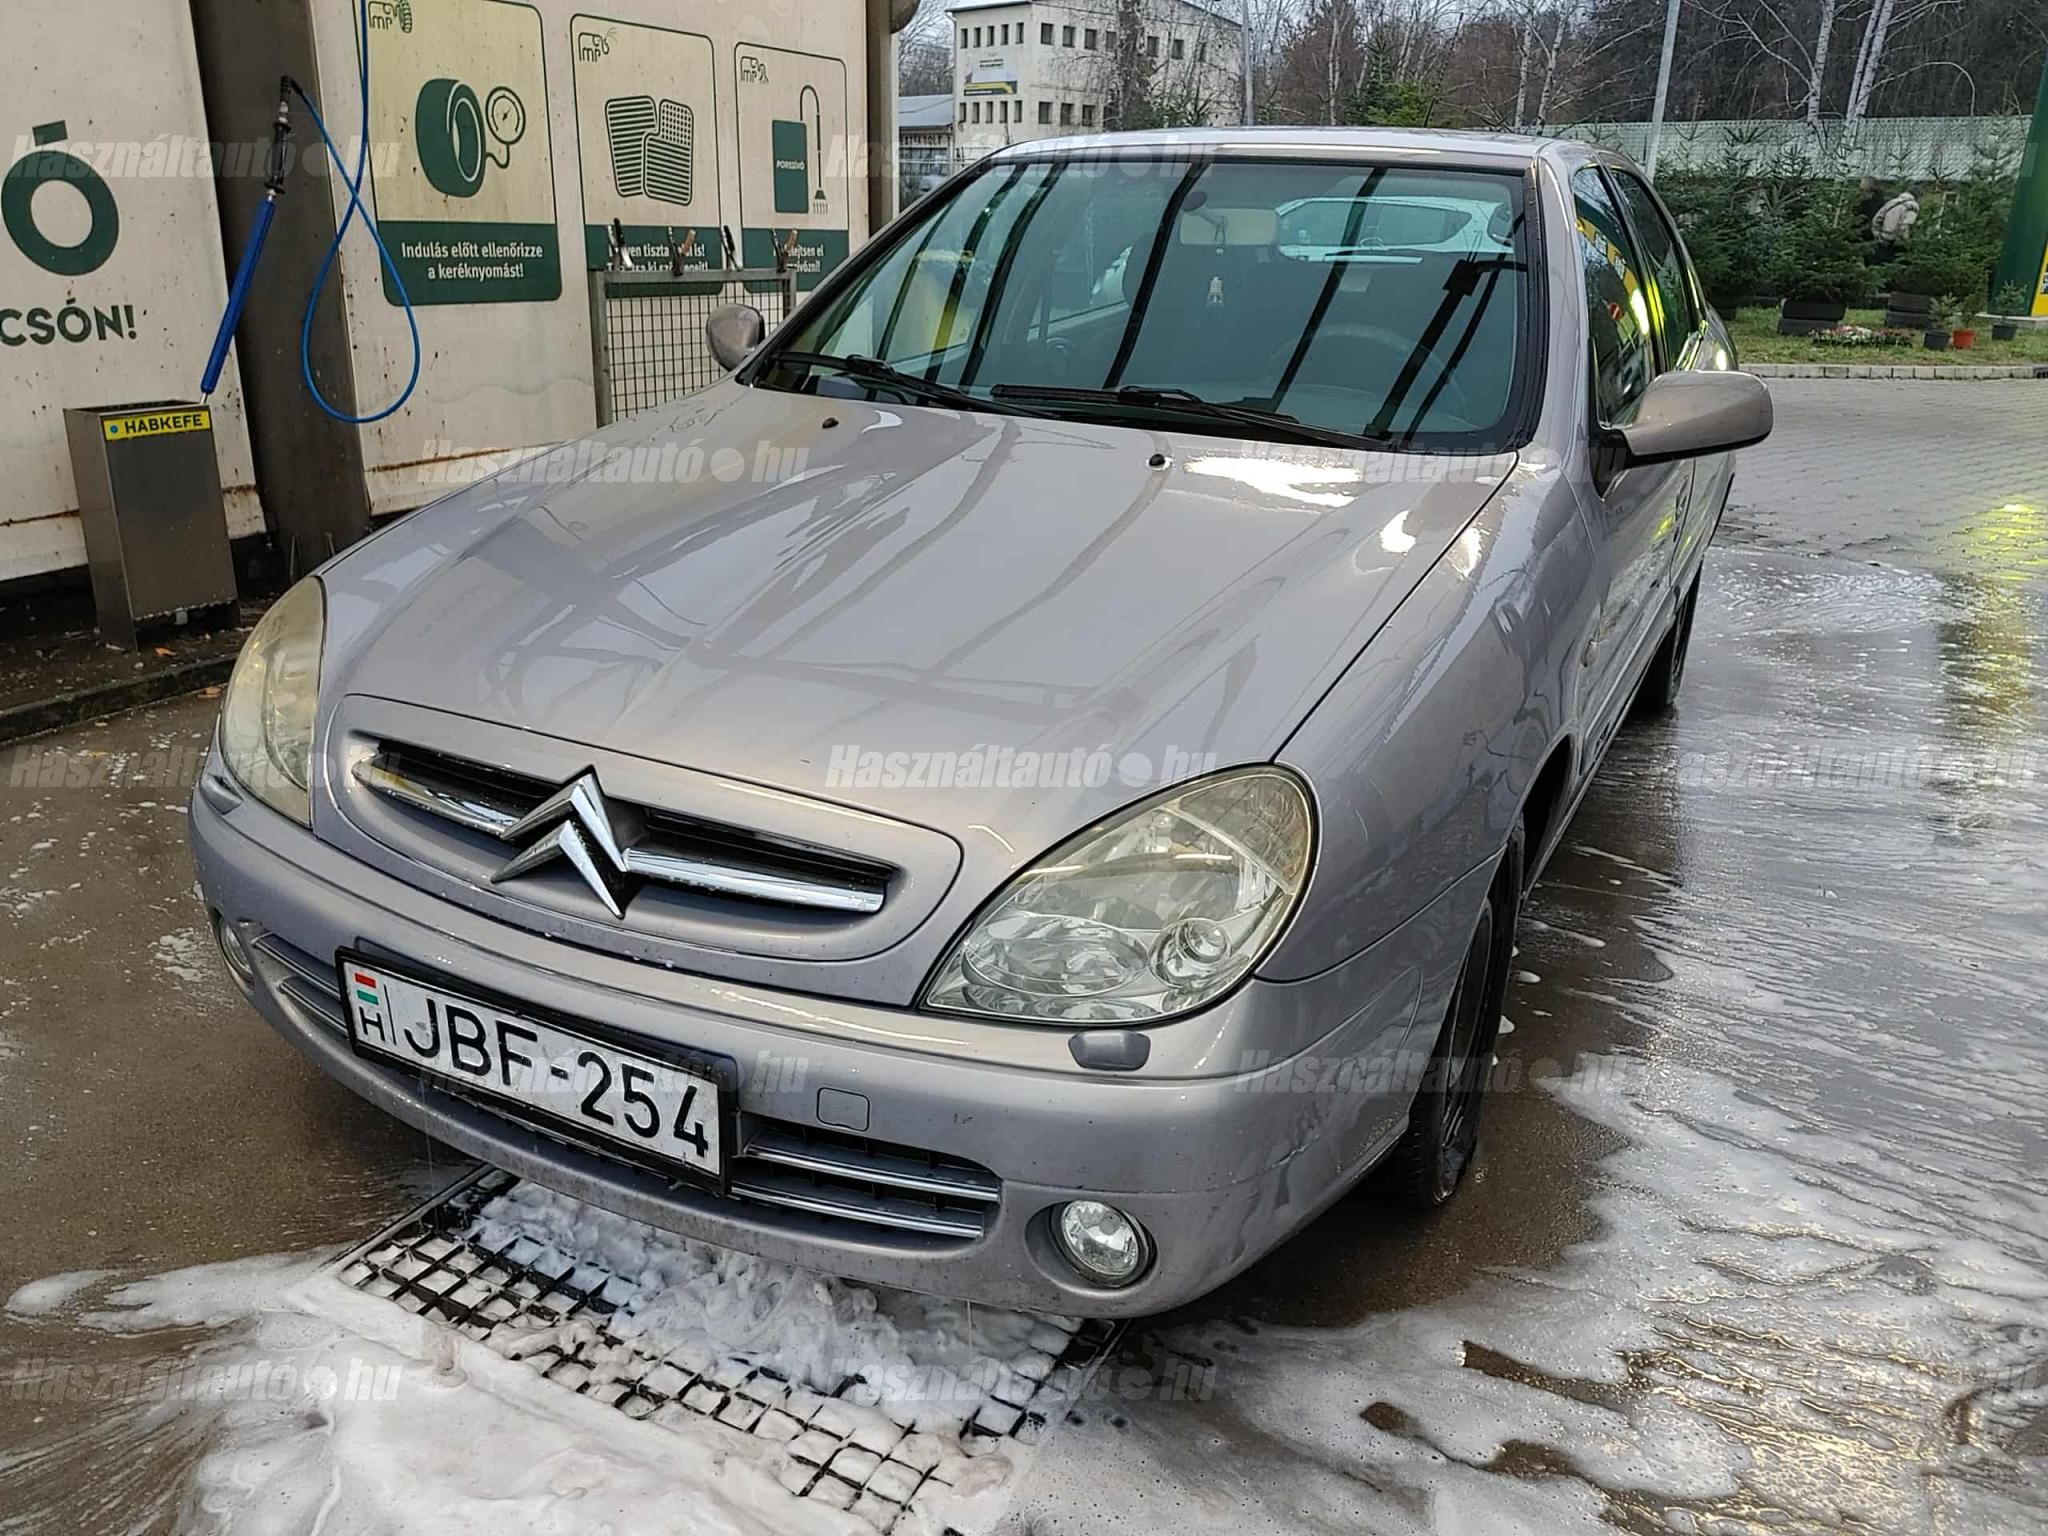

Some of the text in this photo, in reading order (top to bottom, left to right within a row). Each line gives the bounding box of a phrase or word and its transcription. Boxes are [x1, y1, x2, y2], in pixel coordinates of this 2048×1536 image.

[401, 241, 544, 259] Indulás előtt ellenőrizze
[643, 243, 669, 257] tiszta
[428, 263, 524, 282] a keréknyomást!
[125, 414, 203, 434] HABKEFE
[362, 1006, 385, 1042] H
[404, 998, 709, 1158] JBF-254
